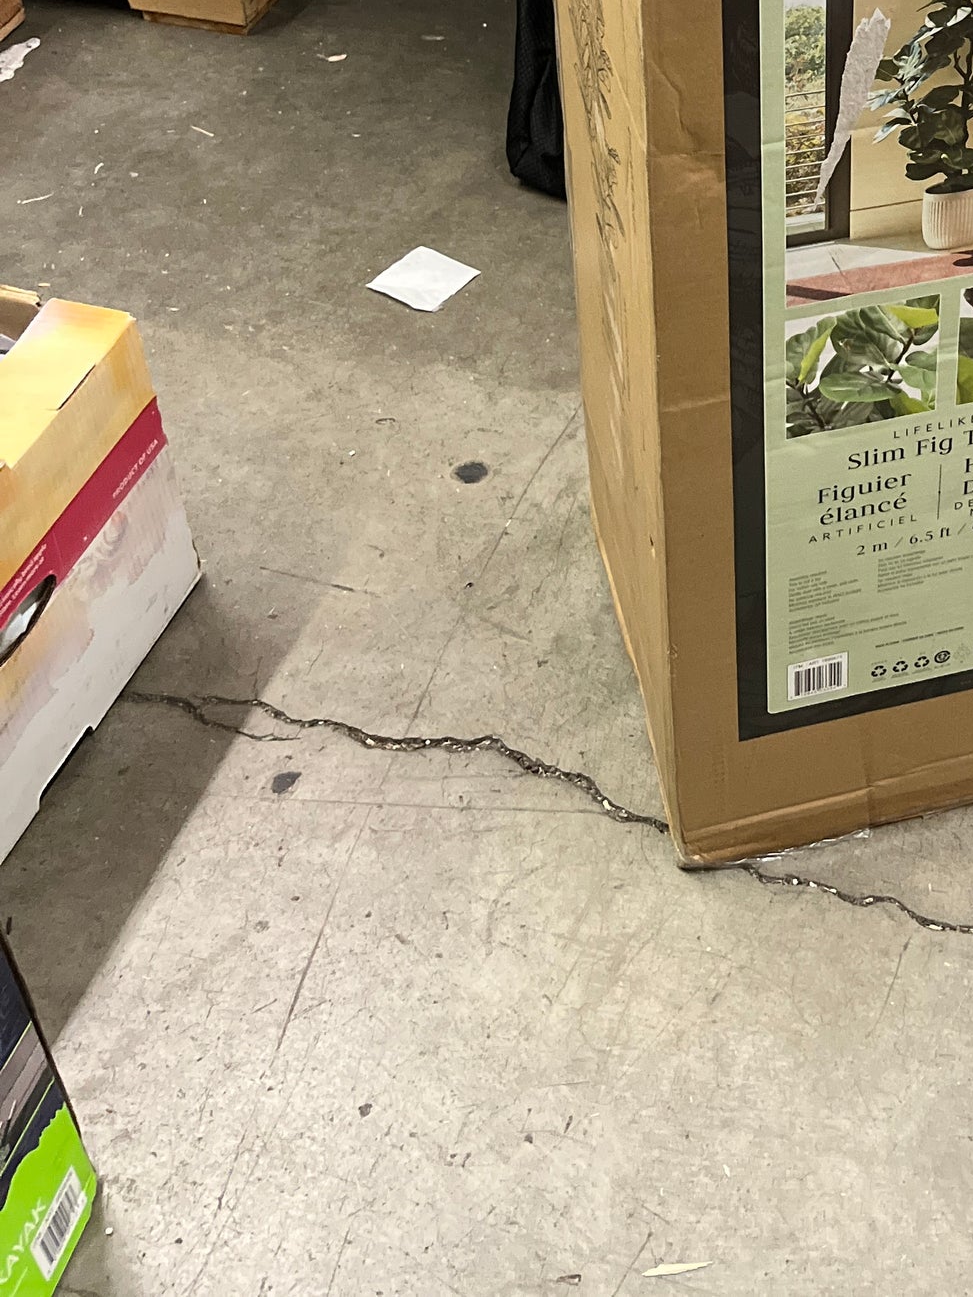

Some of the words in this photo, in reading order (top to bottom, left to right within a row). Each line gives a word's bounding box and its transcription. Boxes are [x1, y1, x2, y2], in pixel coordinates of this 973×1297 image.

[112, 463, 138, 498] PRODUCT
[138, 453, 147, 466] OF
[146, 439, 158, 455] USA
[847, 446, 905, 471] Slim
[915, 436, 954, 456] Fig
[817, 471, 912, 504] Figuier
[820, 492, 908, 527] élancé
[808, 514, 918, 544] ARTIFICIEL
[856, 545, 866, 556] 2
[872, 540, 888, 553] m
[909, 531, 934, 546] 6.5
[938, 525, 952, 539] ft
